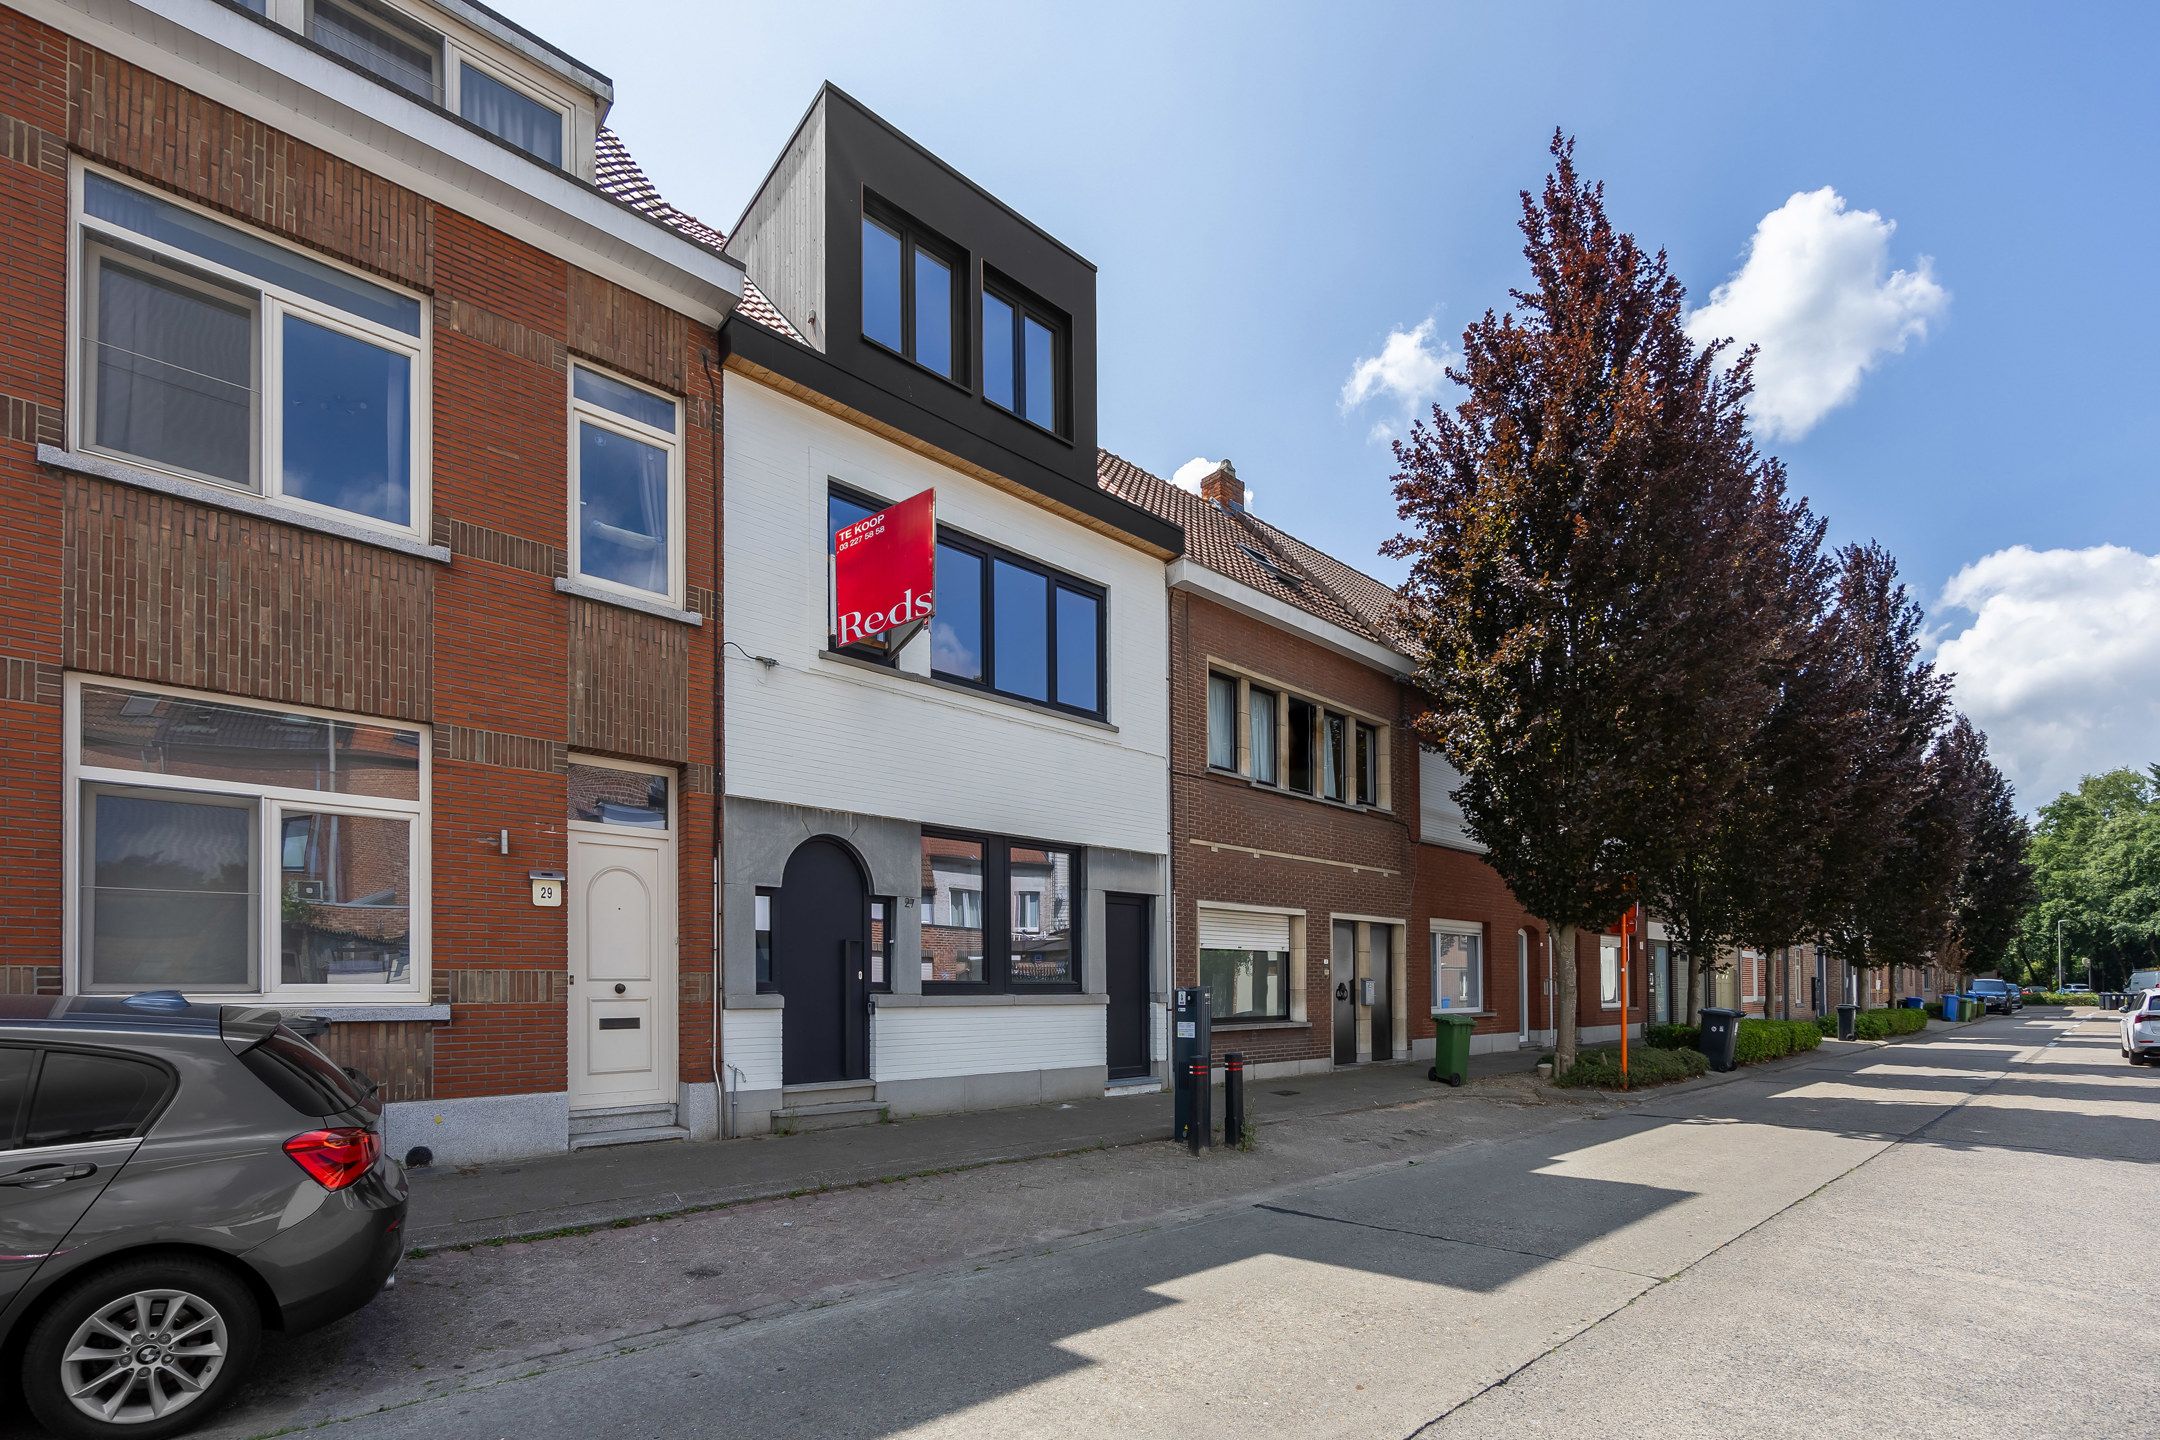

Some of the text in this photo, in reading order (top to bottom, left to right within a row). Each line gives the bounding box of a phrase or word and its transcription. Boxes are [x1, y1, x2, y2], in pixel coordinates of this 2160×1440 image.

[839, 514, 885, 541] TE KOOP
[839, 526, 885, 551] 03 227 58 58
[838, 588, 933, 645] Reds
[541, 887, 552, 899] 29
